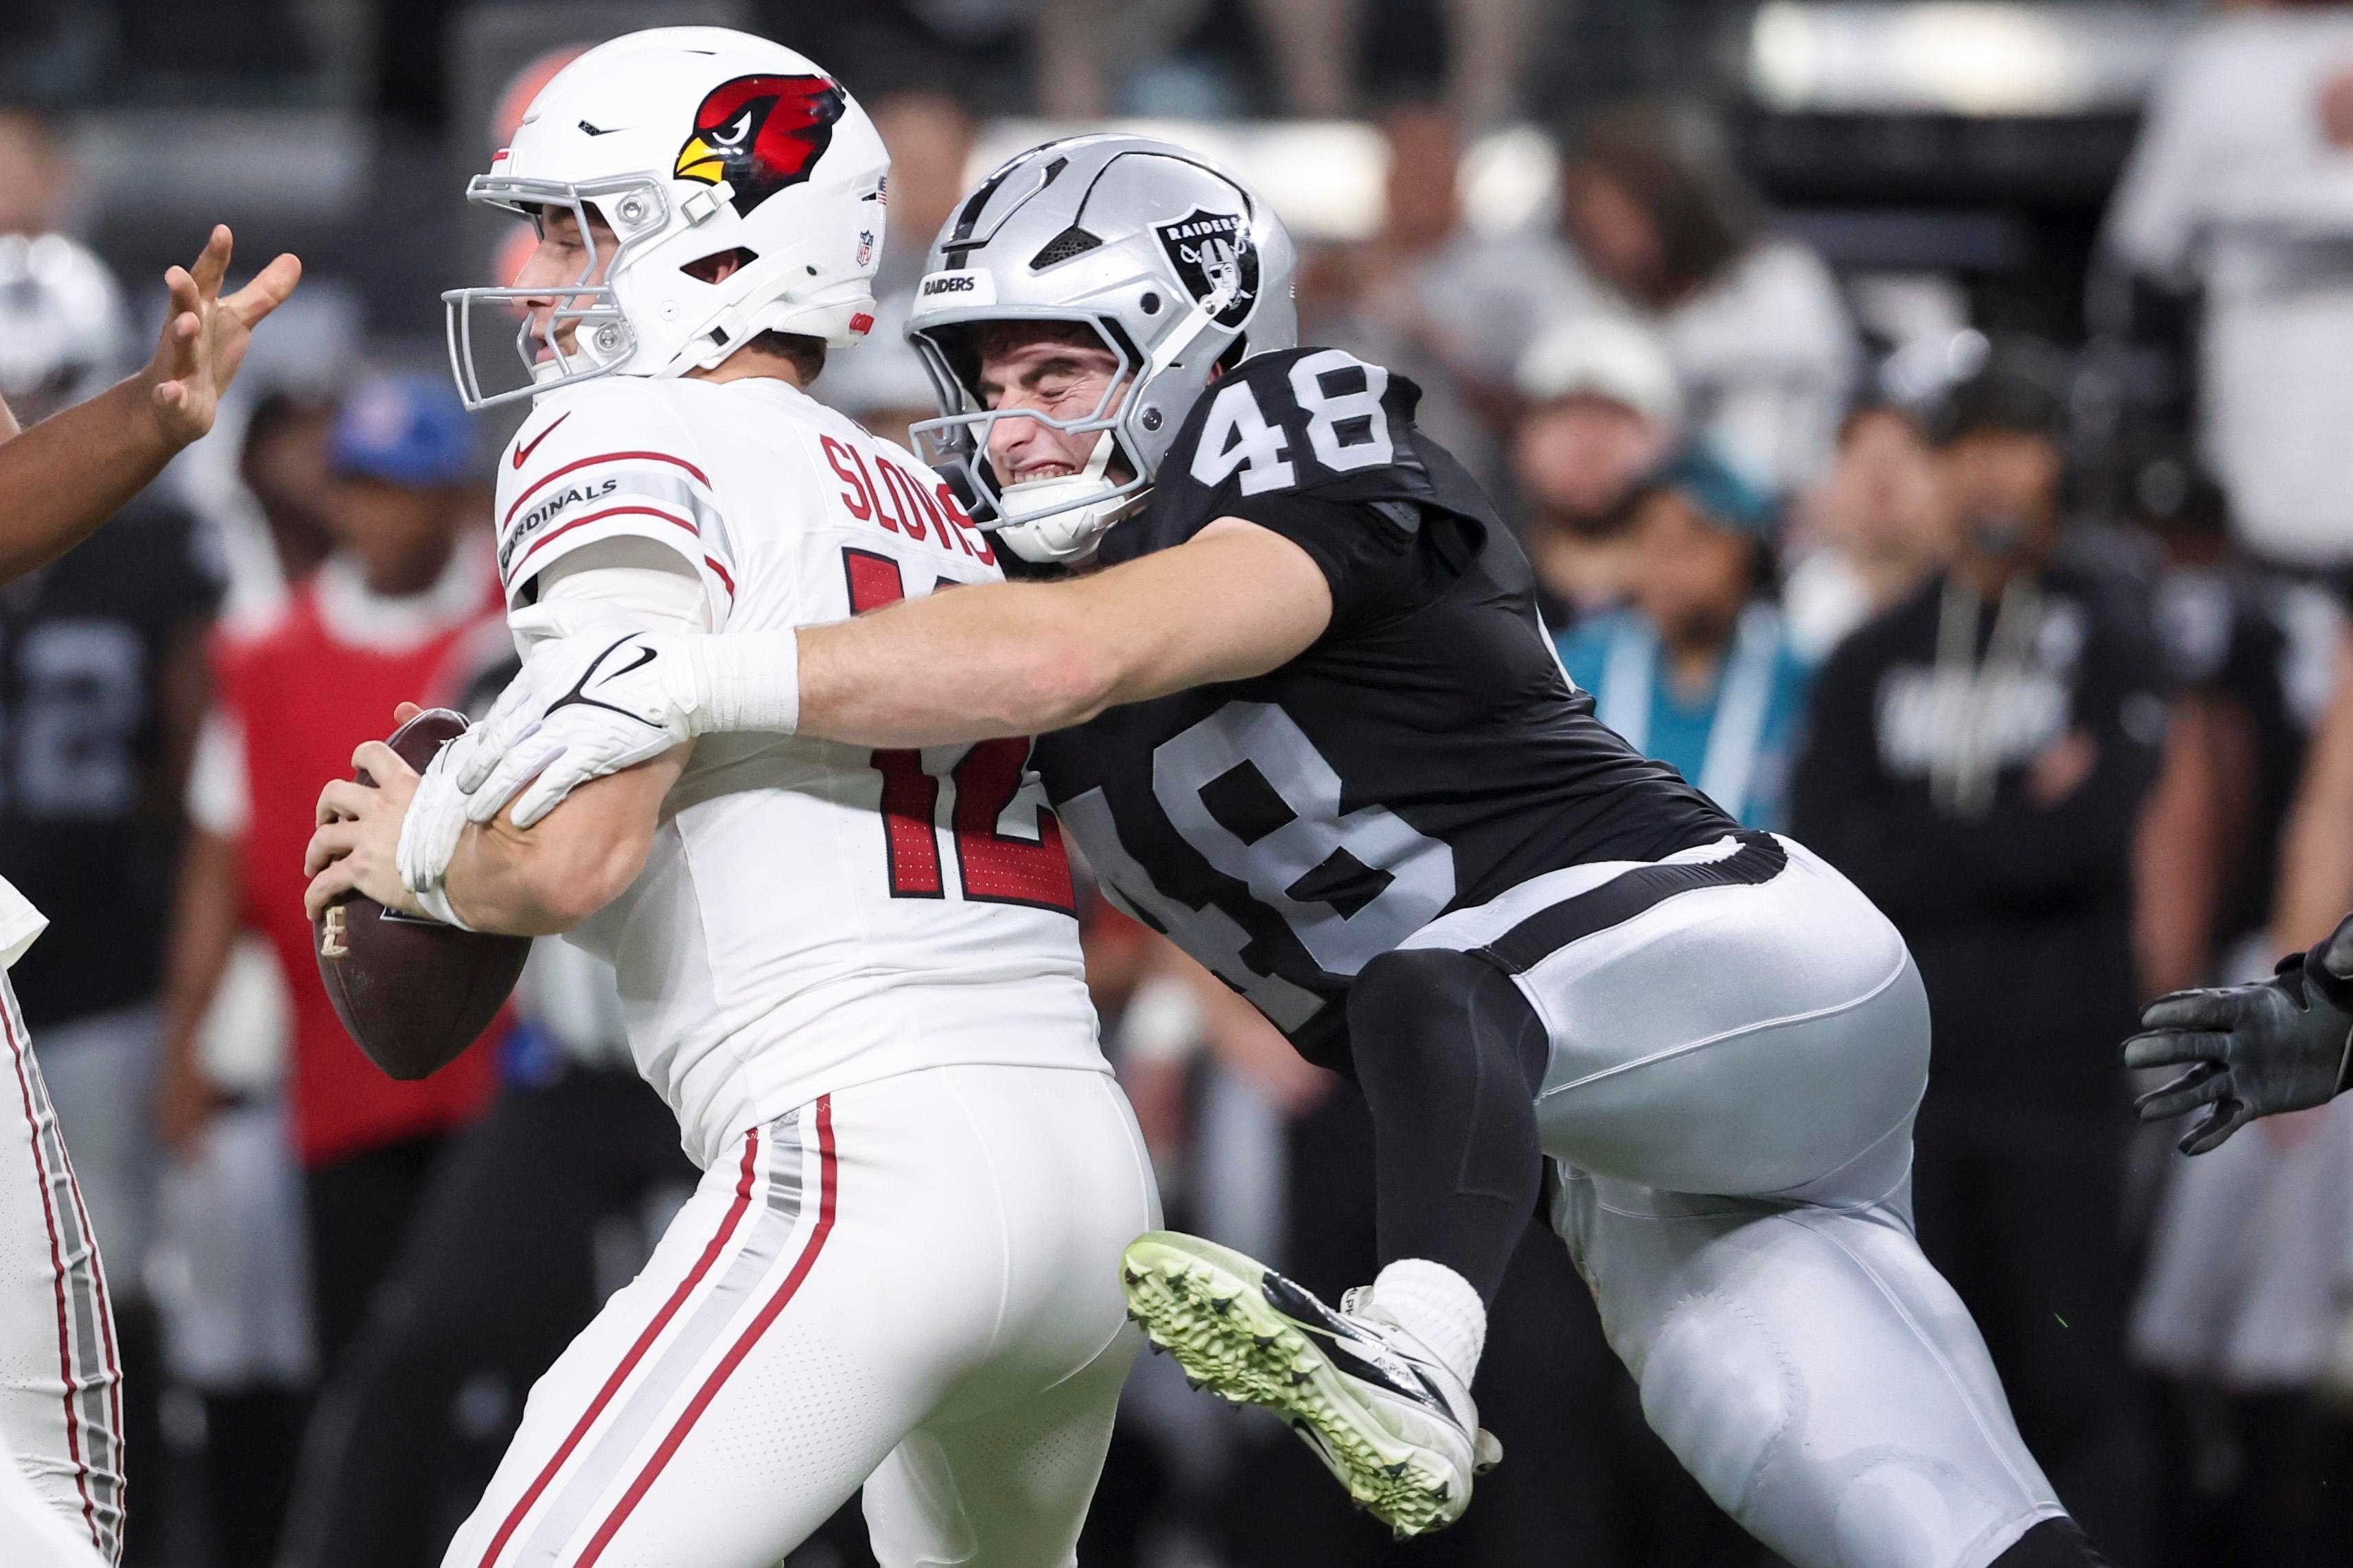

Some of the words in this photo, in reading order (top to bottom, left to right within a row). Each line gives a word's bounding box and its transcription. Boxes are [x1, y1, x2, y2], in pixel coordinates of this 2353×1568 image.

[1166, 217, 1240, 240] RAIDERS
[923, 277, 975, 296] RAIDERS
[1190, 349, 1394, 497] 48
[502, 480, 617, 568] CARDINALS
[1057, 699, 1457, 1034] 48
